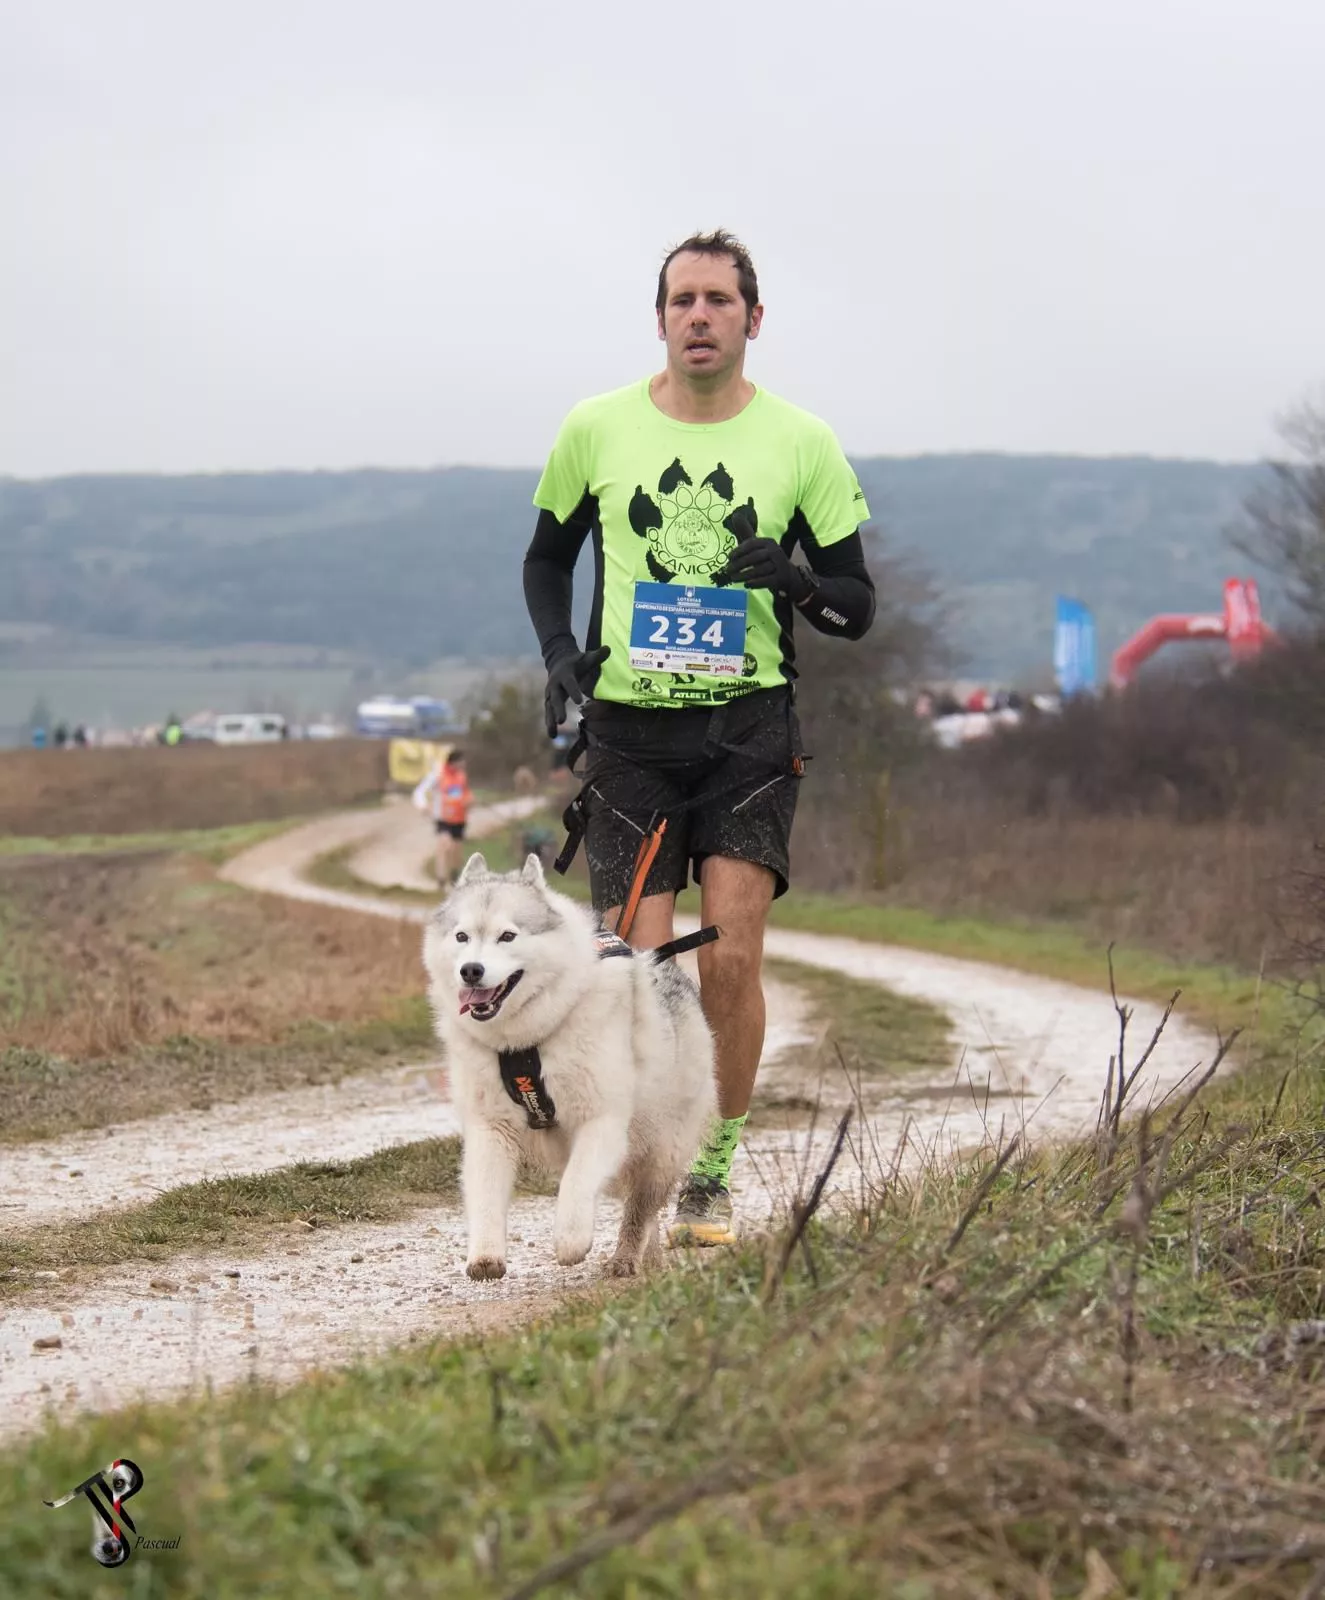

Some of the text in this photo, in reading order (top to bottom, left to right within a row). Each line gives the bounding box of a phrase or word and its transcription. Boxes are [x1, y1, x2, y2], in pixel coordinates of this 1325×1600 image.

[820, 606, 848, 627] KIPRUN
[649, 615, 724, 647] 234
[714, 664, 738, 675] ARION
